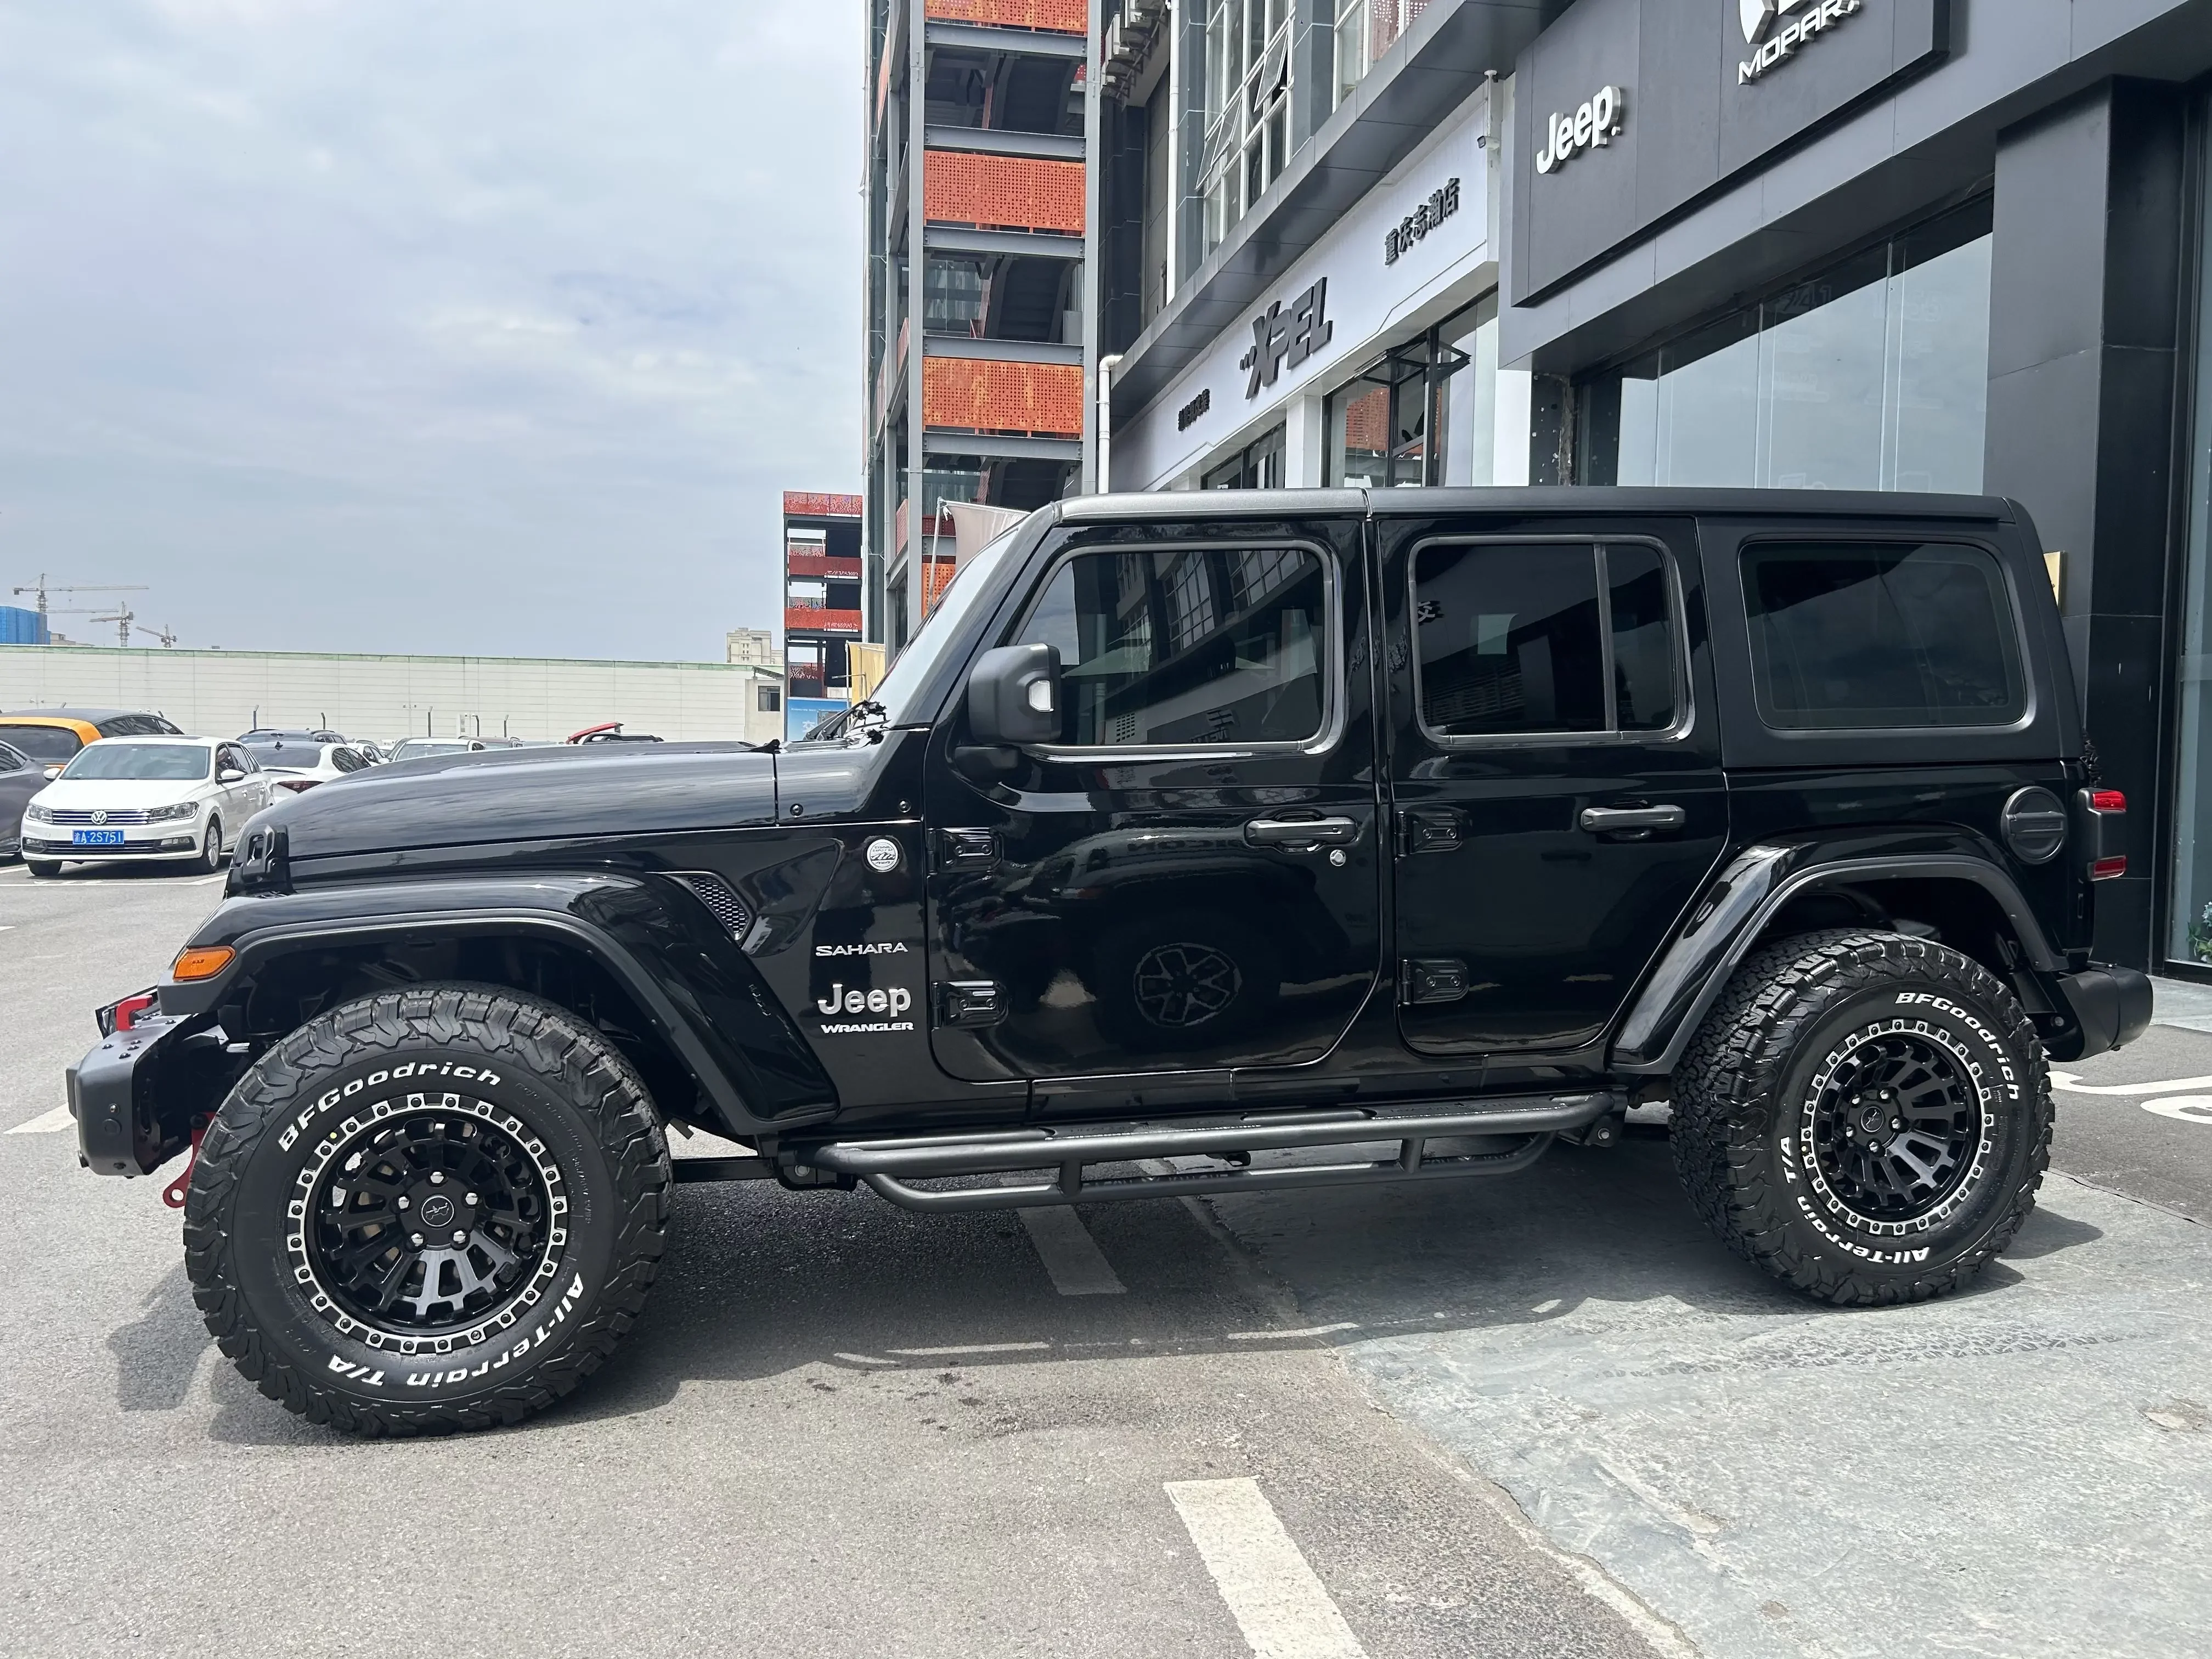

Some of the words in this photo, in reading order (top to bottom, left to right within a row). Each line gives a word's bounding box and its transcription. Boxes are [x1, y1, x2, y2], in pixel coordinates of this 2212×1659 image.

[1240, 277, 1333, 399] XPEL
[815, 942, 909, 957] SAHARA
[817, 983, 911, 1017] Jeep
[821, 1022, 914, 1034] WRANGLER
[1895, 992, 2019, 1100] BFGoodrich
[278, 1062, 501, 1152] BFGoodrich
[1780, 1136, 1796, 1184] T/A
[326, 1353, 385, 1386] T/A
